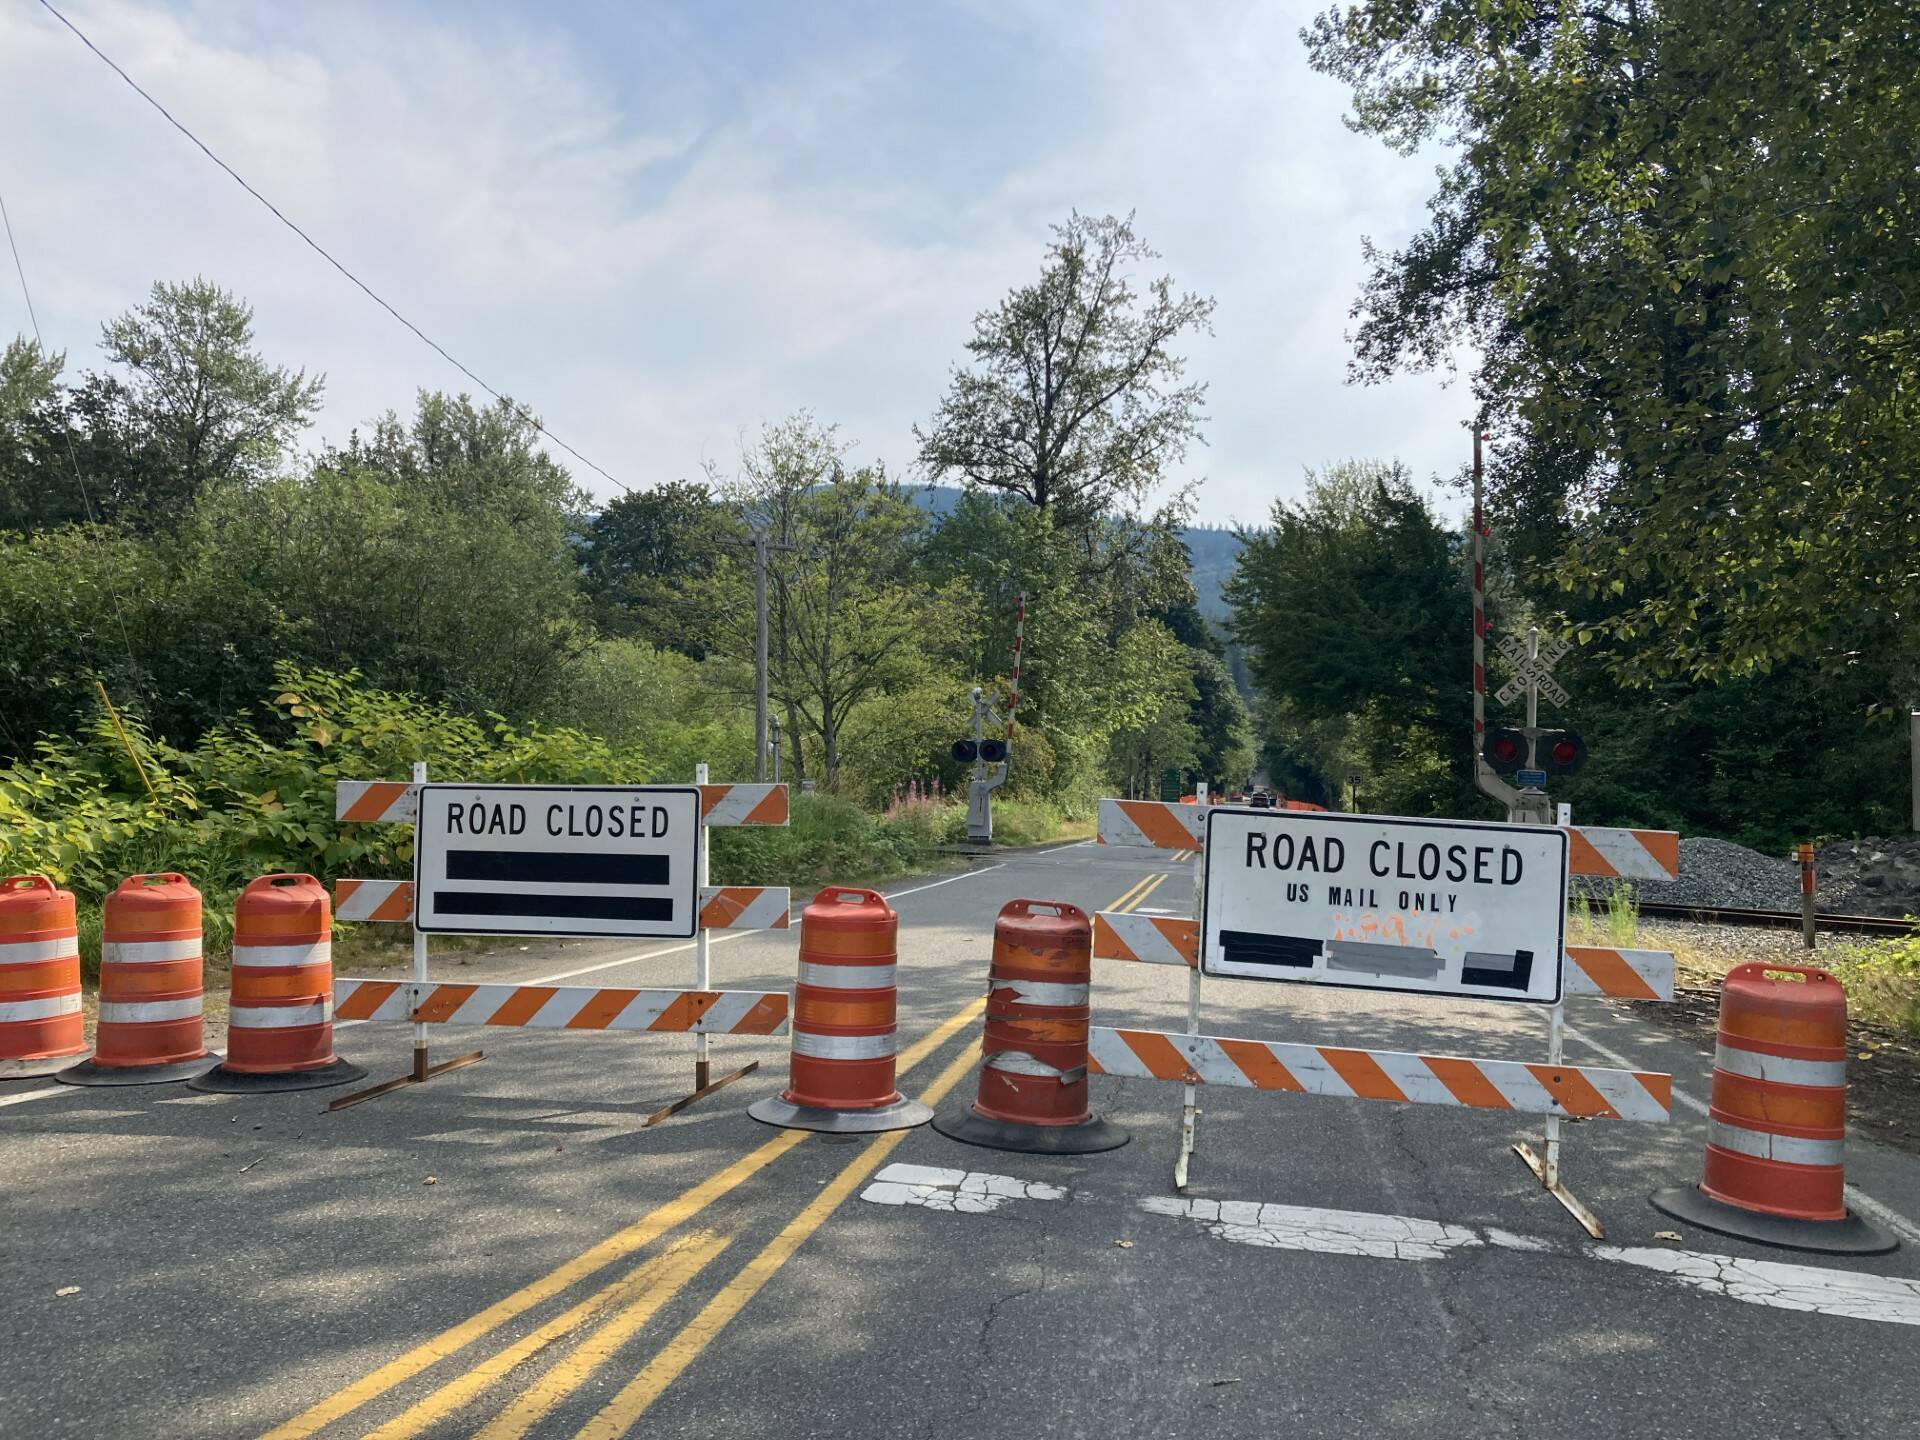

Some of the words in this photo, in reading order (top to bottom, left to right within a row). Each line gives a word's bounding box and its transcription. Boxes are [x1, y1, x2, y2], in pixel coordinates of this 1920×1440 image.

[1500, 640, 1568, 702] CROSSING
[1347, 775, 1361, 785] 35
[447, 803, 526, 835] ROAD
[546, 805, 669, 838] CLOSED
[1246, 832, 1345, 873] ROAD
[1369, 840, 1523, 885] CLOSED
[1287, 883, 1309, 902] US
[1328, 886, 1378, 909] MAIL
[1399, 891, 1458, 912] ONLY
